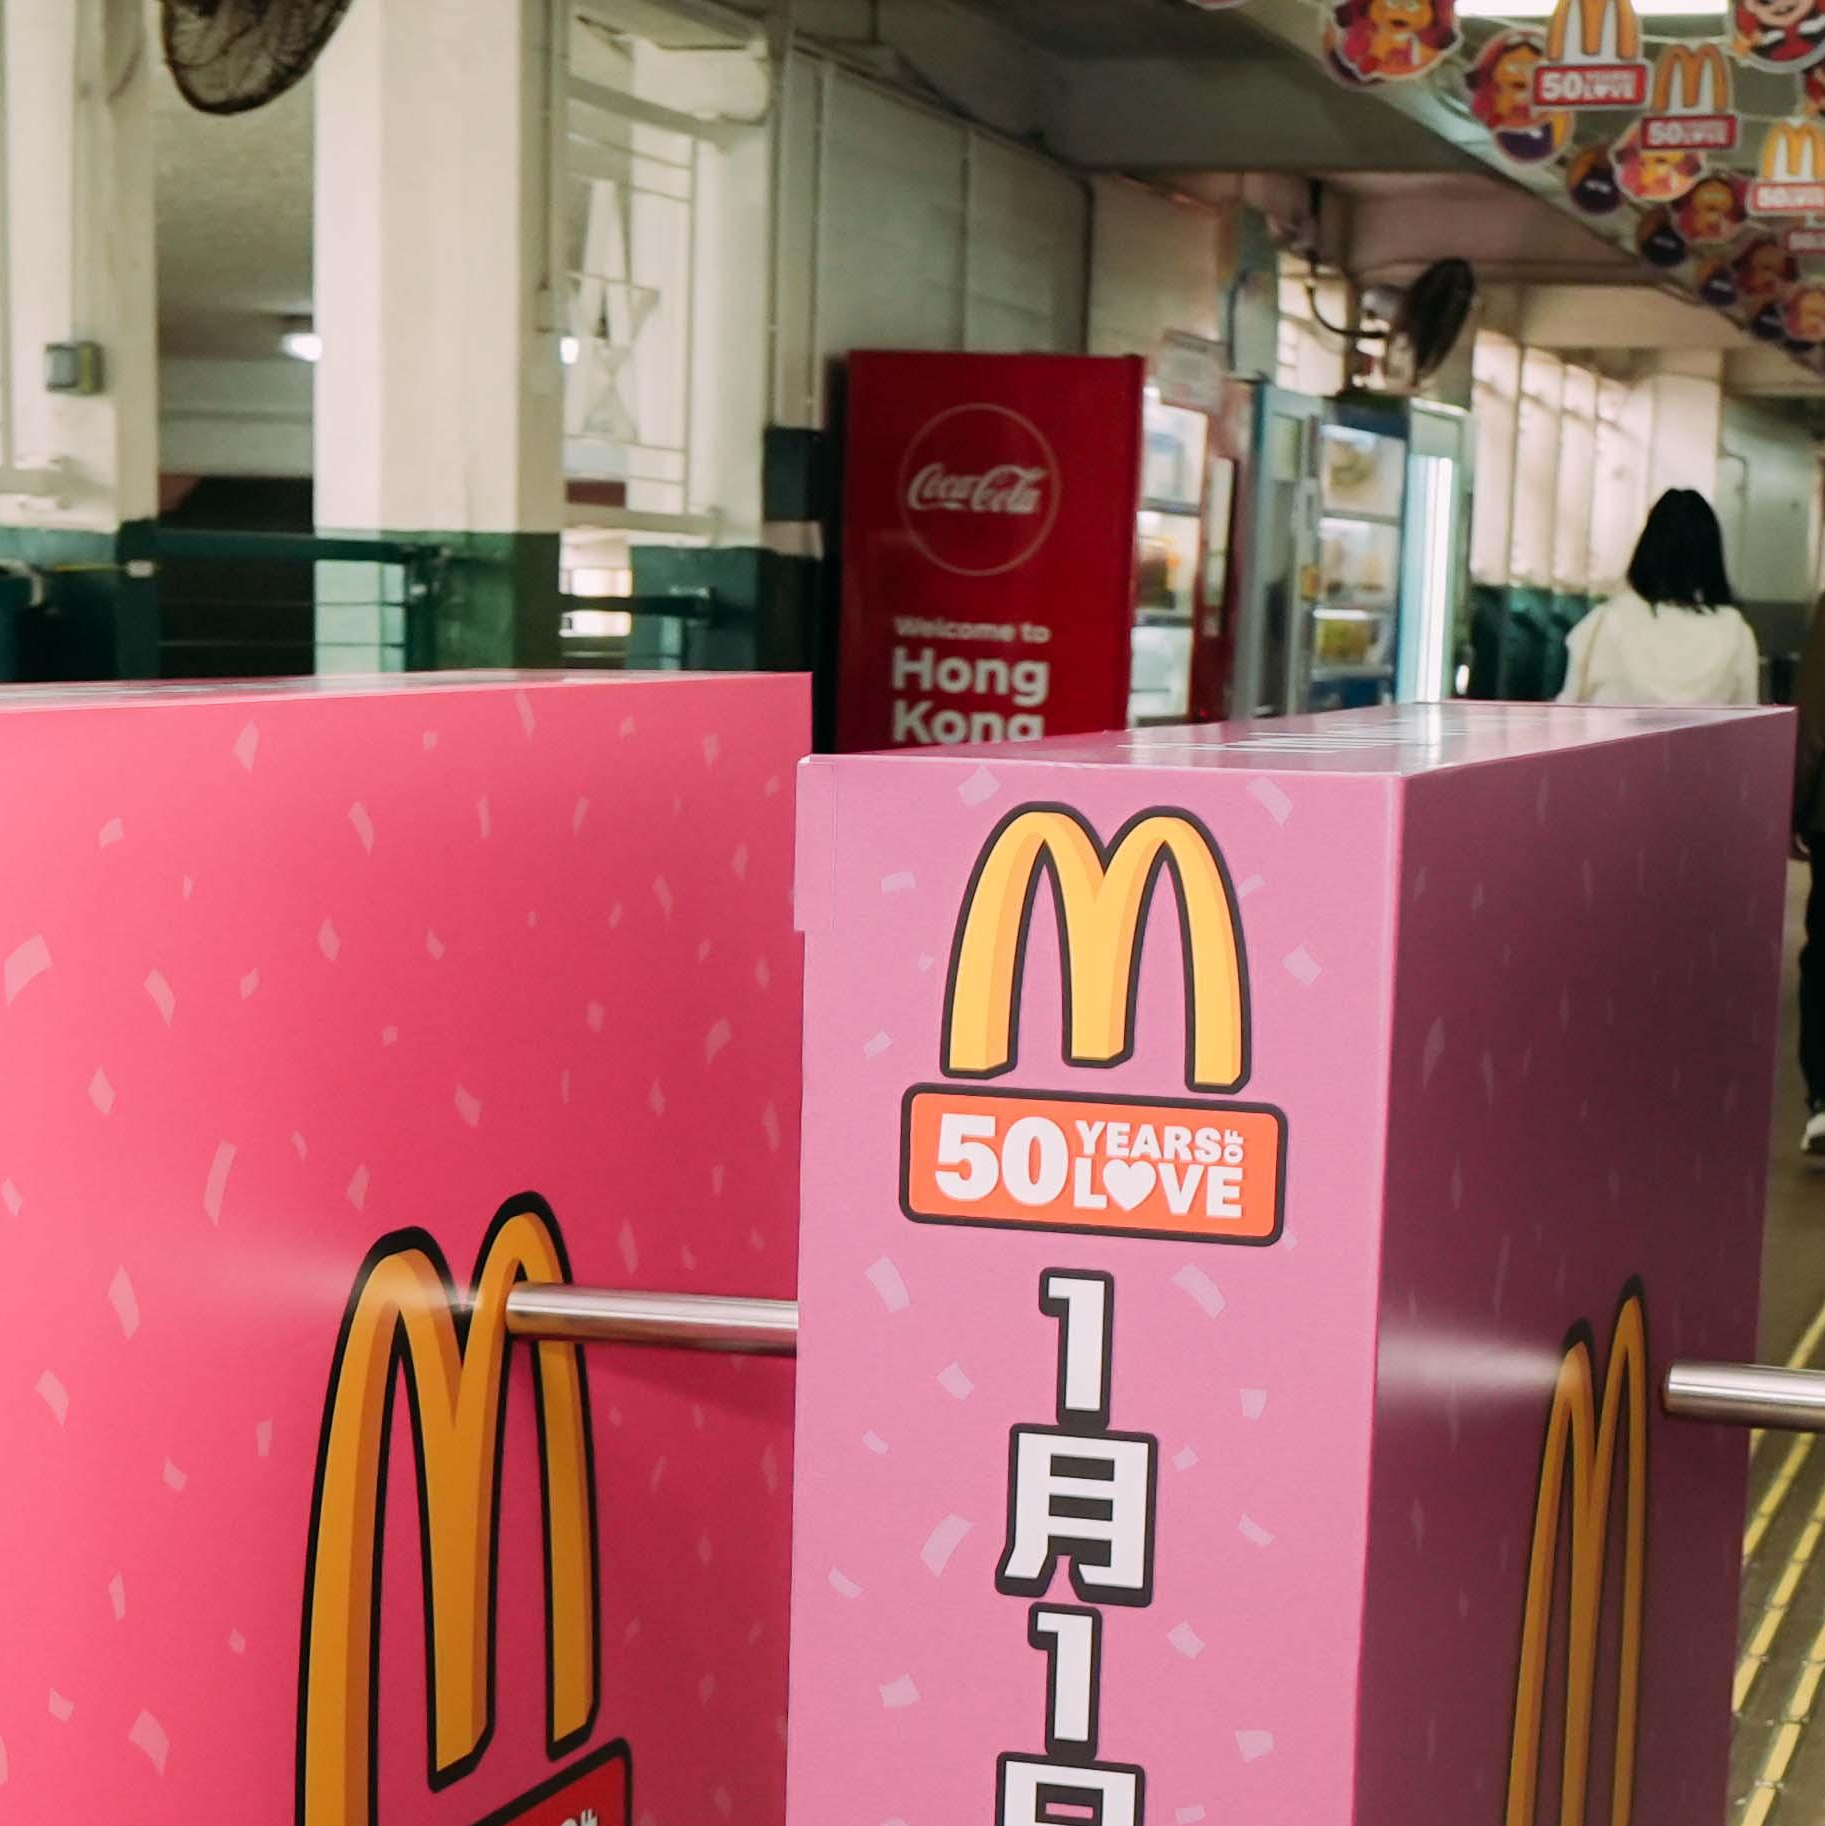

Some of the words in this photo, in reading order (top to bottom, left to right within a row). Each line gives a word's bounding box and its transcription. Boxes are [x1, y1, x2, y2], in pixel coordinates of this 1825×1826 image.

[1542, 72, 1583, 101] 50
[894, 617, 1015, 642] Welcome
[1020, 622, 1051, 643] to
[893, 646, 1050, 706] Hong
[934, 1112, 1069, 1206] 50
[1075, 1120, 1222, 1163] YEARS
[1223, 1128, 1244, 1163] OF
